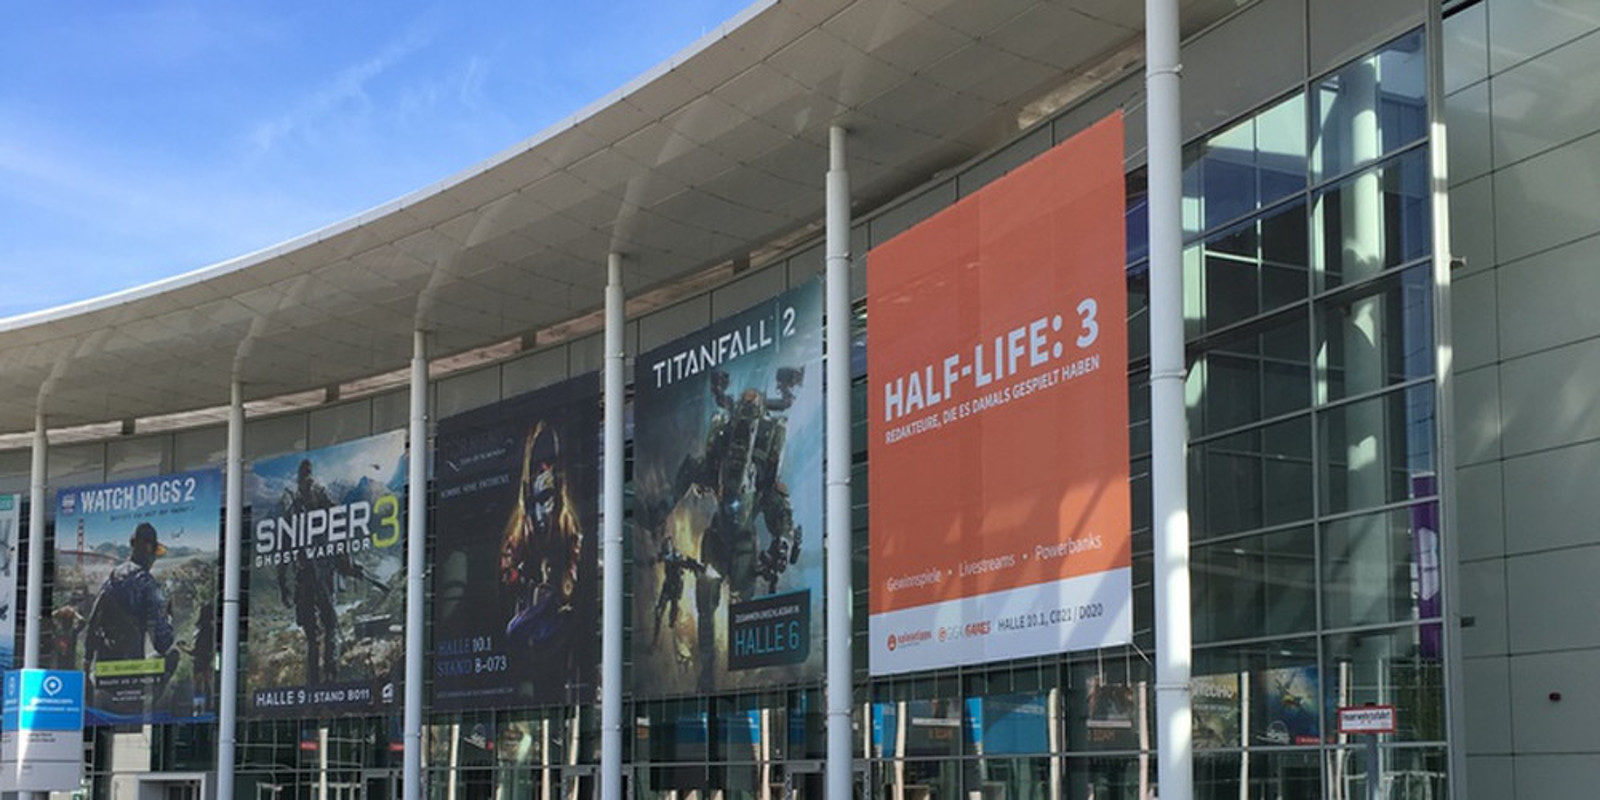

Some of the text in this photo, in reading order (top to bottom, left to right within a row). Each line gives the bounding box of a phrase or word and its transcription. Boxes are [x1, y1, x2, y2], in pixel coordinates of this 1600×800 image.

[652, 305, 797, 389] TITANFALL 2
[884, 297, 1100, 423] HALF-LIFE: 3
[884, 354, 1100, 445] REDAKTEURE, DIE ES DAMALS GESPIELT HABEN
[184, 476, 197, 502] 2
[255, 494, 400, 554] SNIPER 3
[255, 537, 371, 569] GHOST WARRIOR
[886, 532, 1102, 592] Gewinnspiele Livestreams Powerbanks
[735, 620, 800, 656] HALLE 6
[998, 615, 1026, 632] HALLE
[437, 638, 470, 654] HALLE
[436, 659, 472, 677] STAND
[255, 690, 295, 707] HALLE
[297, 689, 306, 705] 9
[313, 690, 345, 704] STAND
